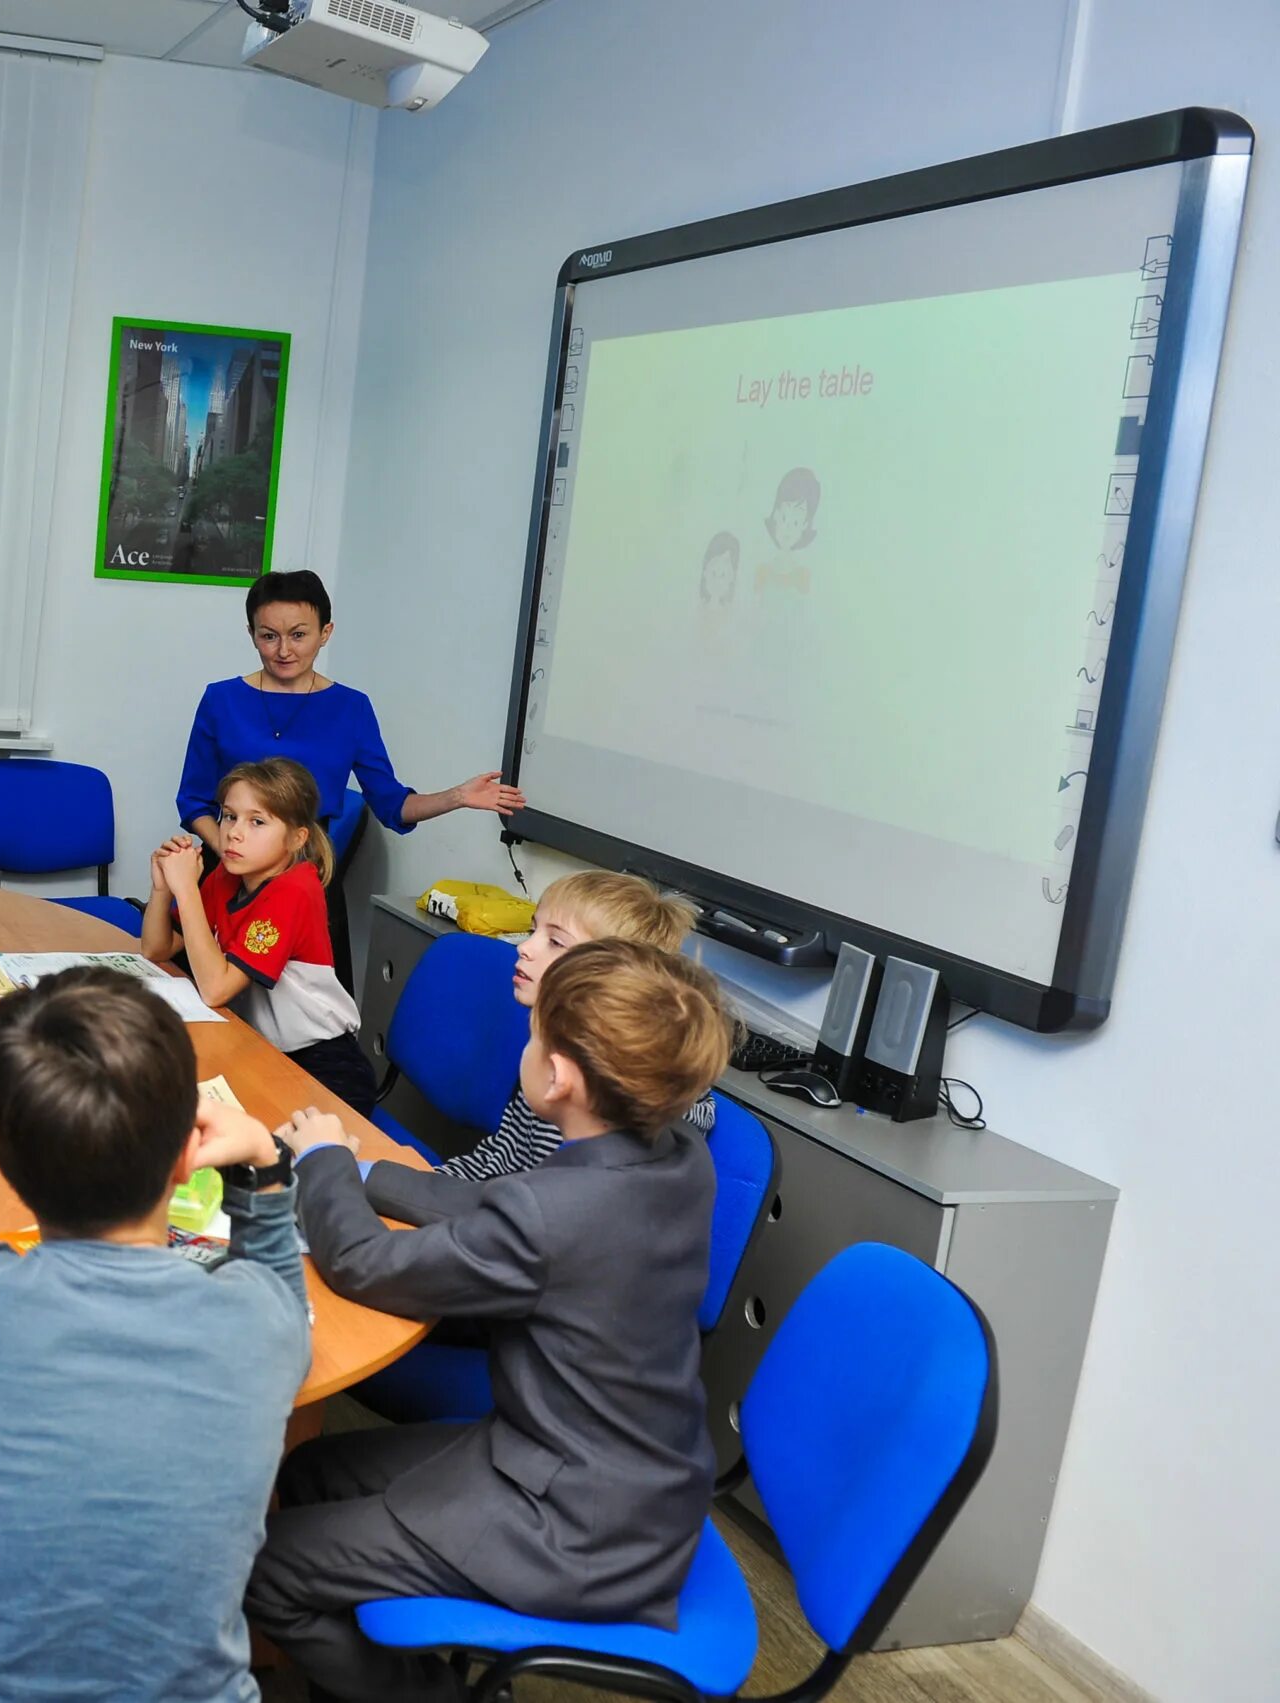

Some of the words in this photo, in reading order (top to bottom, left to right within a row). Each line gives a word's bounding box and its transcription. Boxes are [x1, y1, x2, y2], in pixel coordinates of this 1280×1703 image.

[129, 339, 153, 350] New
[155, 341, 178, 353] York
[736, 373, 773, 408] Lay
[778, 370, 811, 400] the
[819, 364, 874, 398] table
[110, 544, 150, 566] Ace
